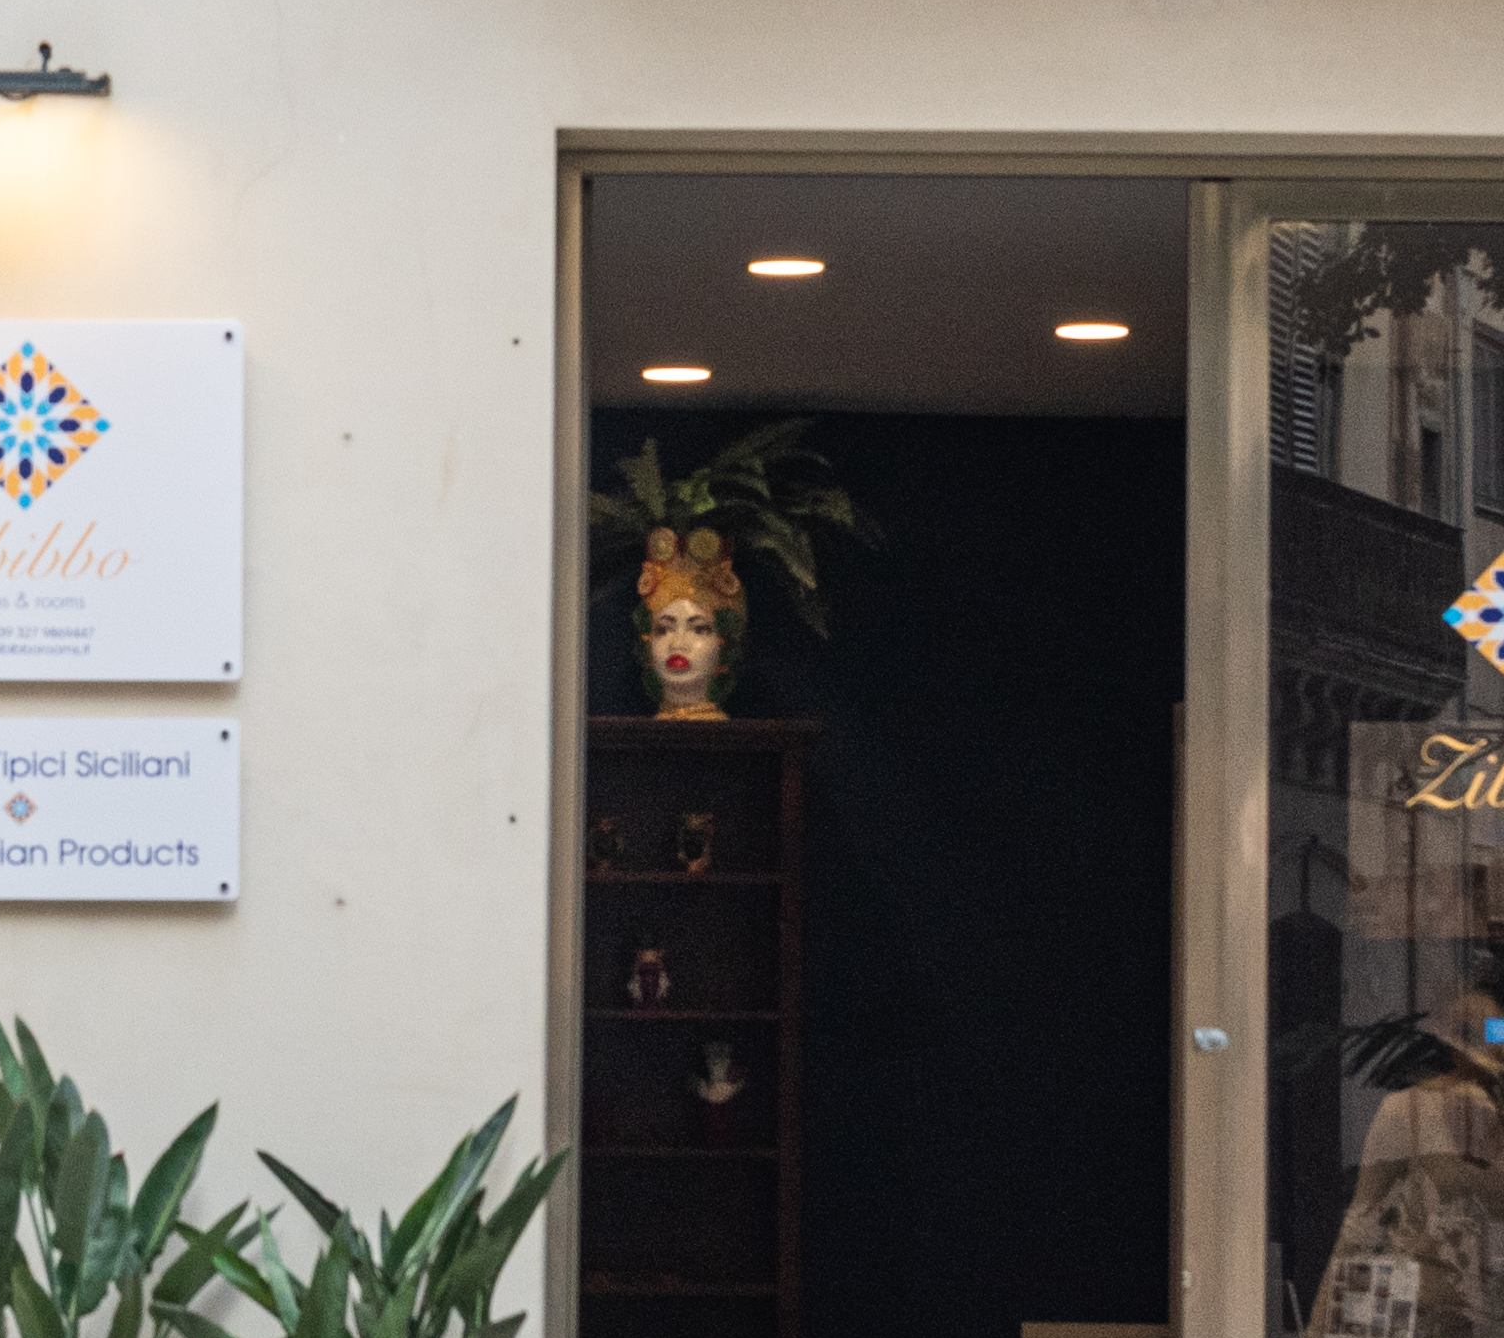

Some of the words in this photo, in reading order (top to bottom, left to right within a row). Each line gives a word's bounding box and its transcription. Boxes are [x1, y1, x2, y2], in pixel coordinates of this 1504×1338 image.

[34, 595, 86, 610] rooms
[75, 748, 191, 780] Siciliani
[58, 838, 200, 867] Products
